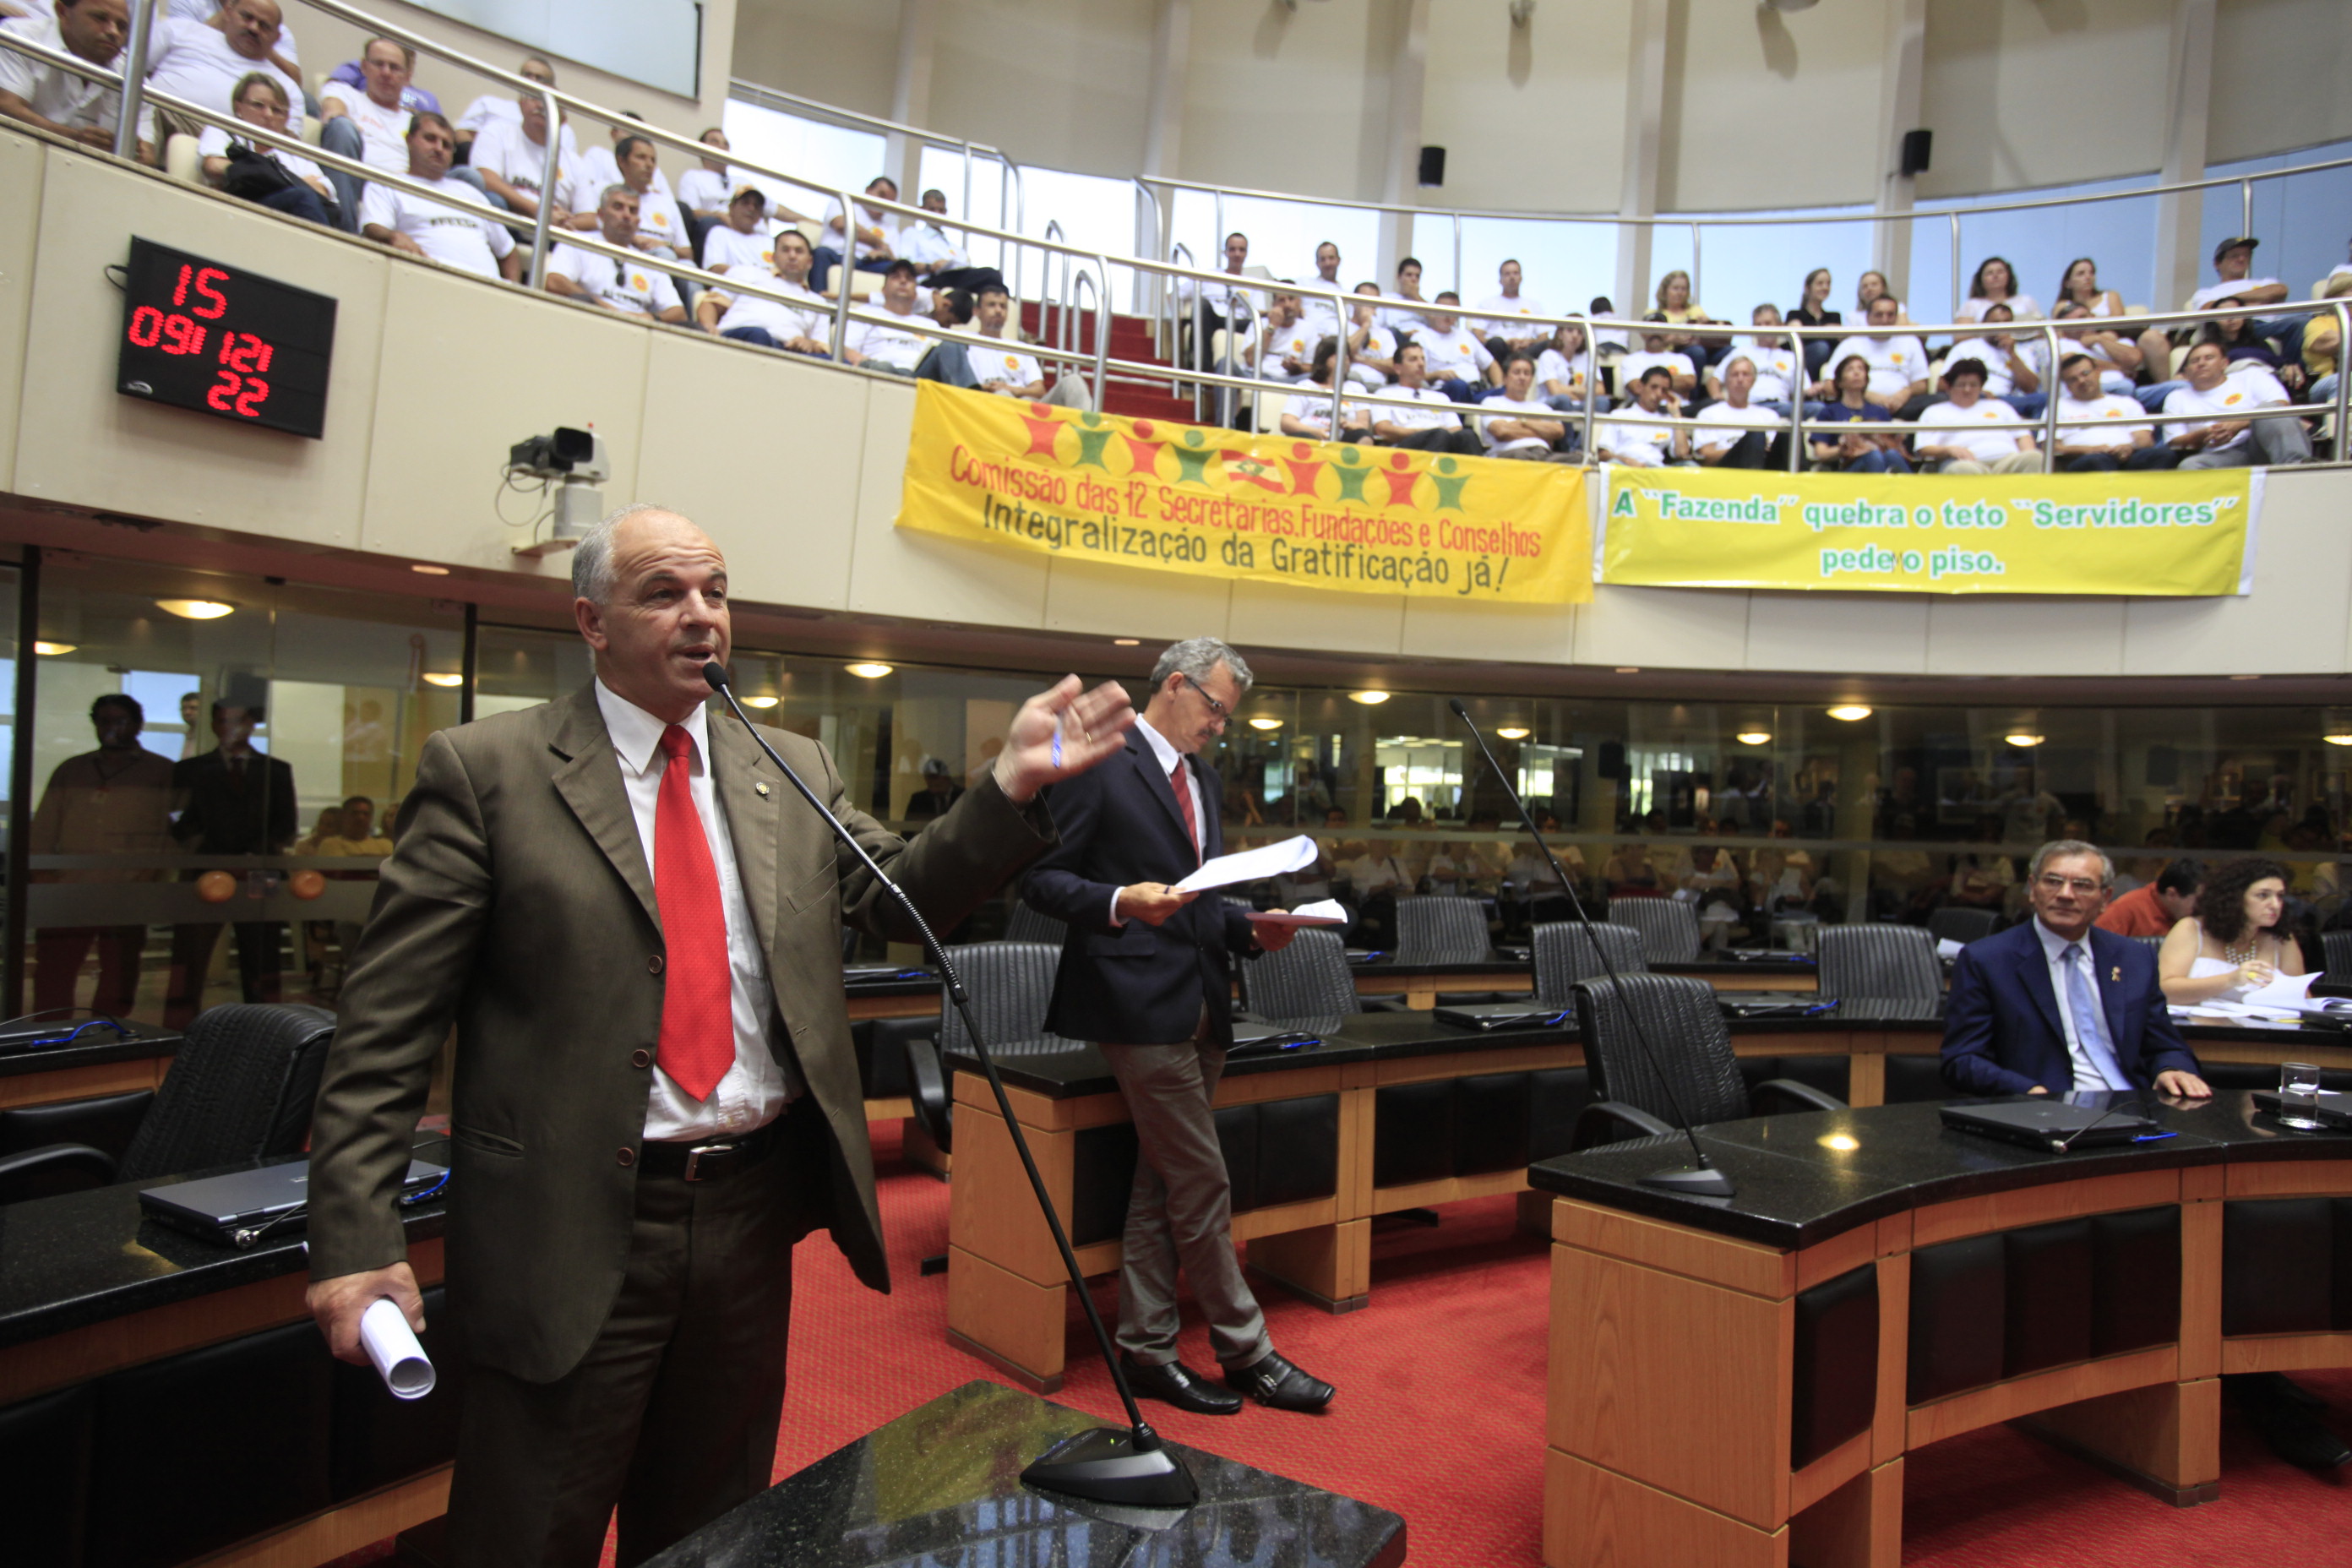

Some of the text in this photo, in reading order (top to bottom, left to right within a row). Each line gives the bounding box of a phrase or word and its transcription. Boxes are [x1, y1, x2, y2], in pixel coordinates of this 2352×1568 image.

[173, 264, 230, 319] 15
[207, 370, 270, 417] 22
[950, 444, 1067, 505] Comissão
[1075, 473, 1119, 515] das
[1124, 480, 1149, 519] 12
[1418, 523, 1431, 547] e
[1439, 518, 1542, 558] Conselhos
[1613, 490, 1634, 515] A
[1805, 501, 1906, 529] quebra
[1914, 505, 1932, 526] o
[1943, 500, 2005, 527] teto
[984, 494, 1207, 564] Integralização
[1222, 532, 1255, 569] da
[1271, 537, 1449, 588] Gratificação
[1931, 546, 2003, 578] piso.
